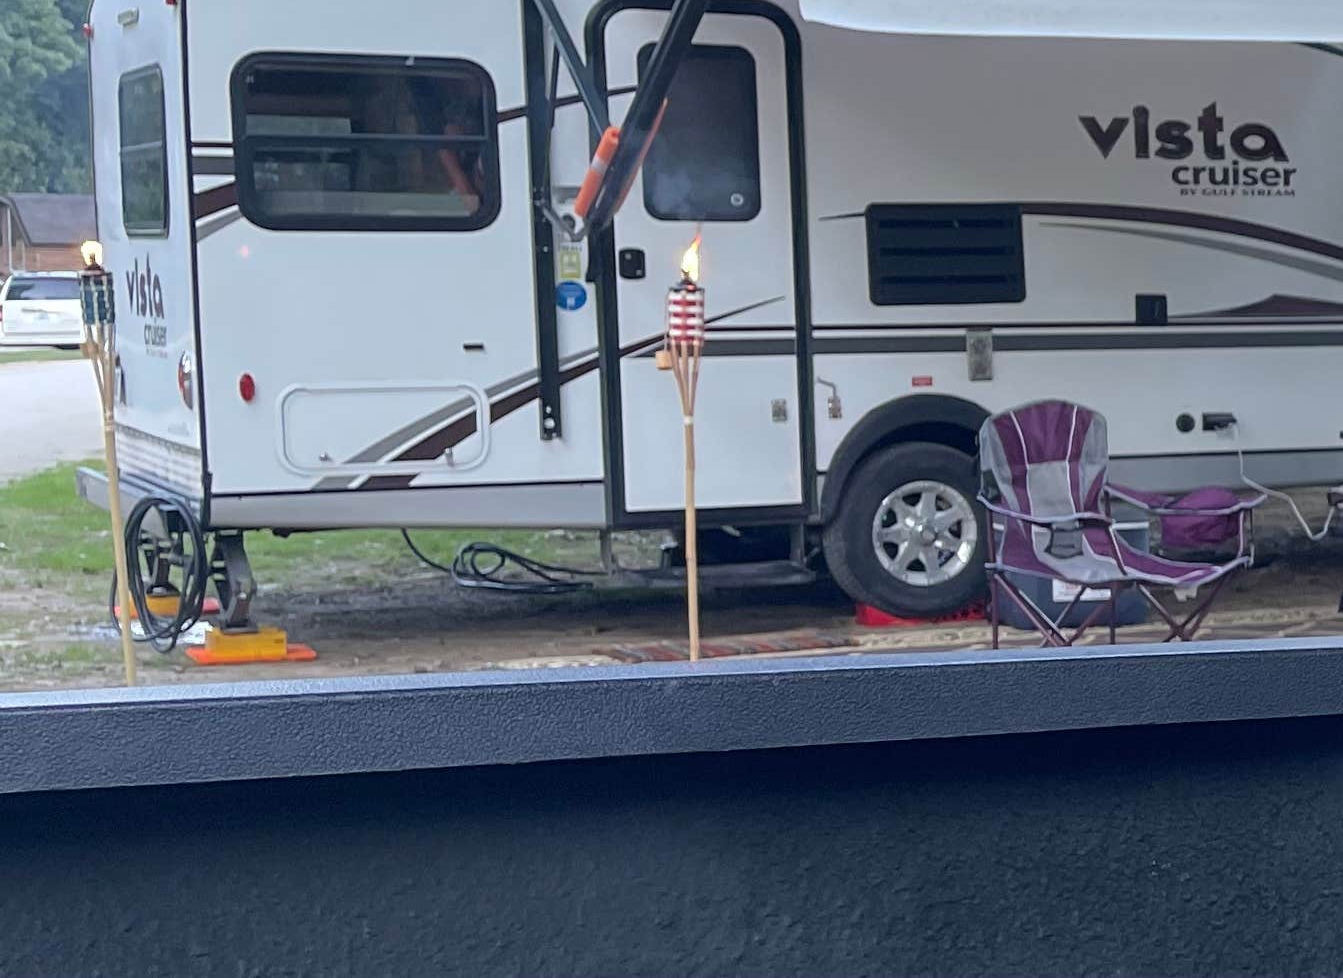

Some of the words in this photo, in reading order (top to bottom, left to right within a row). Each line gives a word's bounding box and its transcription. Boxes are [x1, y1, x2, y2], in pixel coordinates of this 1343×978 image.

[1078, 101, 1290, 162] vista
[1171, 160, 1297, 188] cruiser
[1179, 188, 1196, 197] BY
[126, 251, 165, 319] vista
